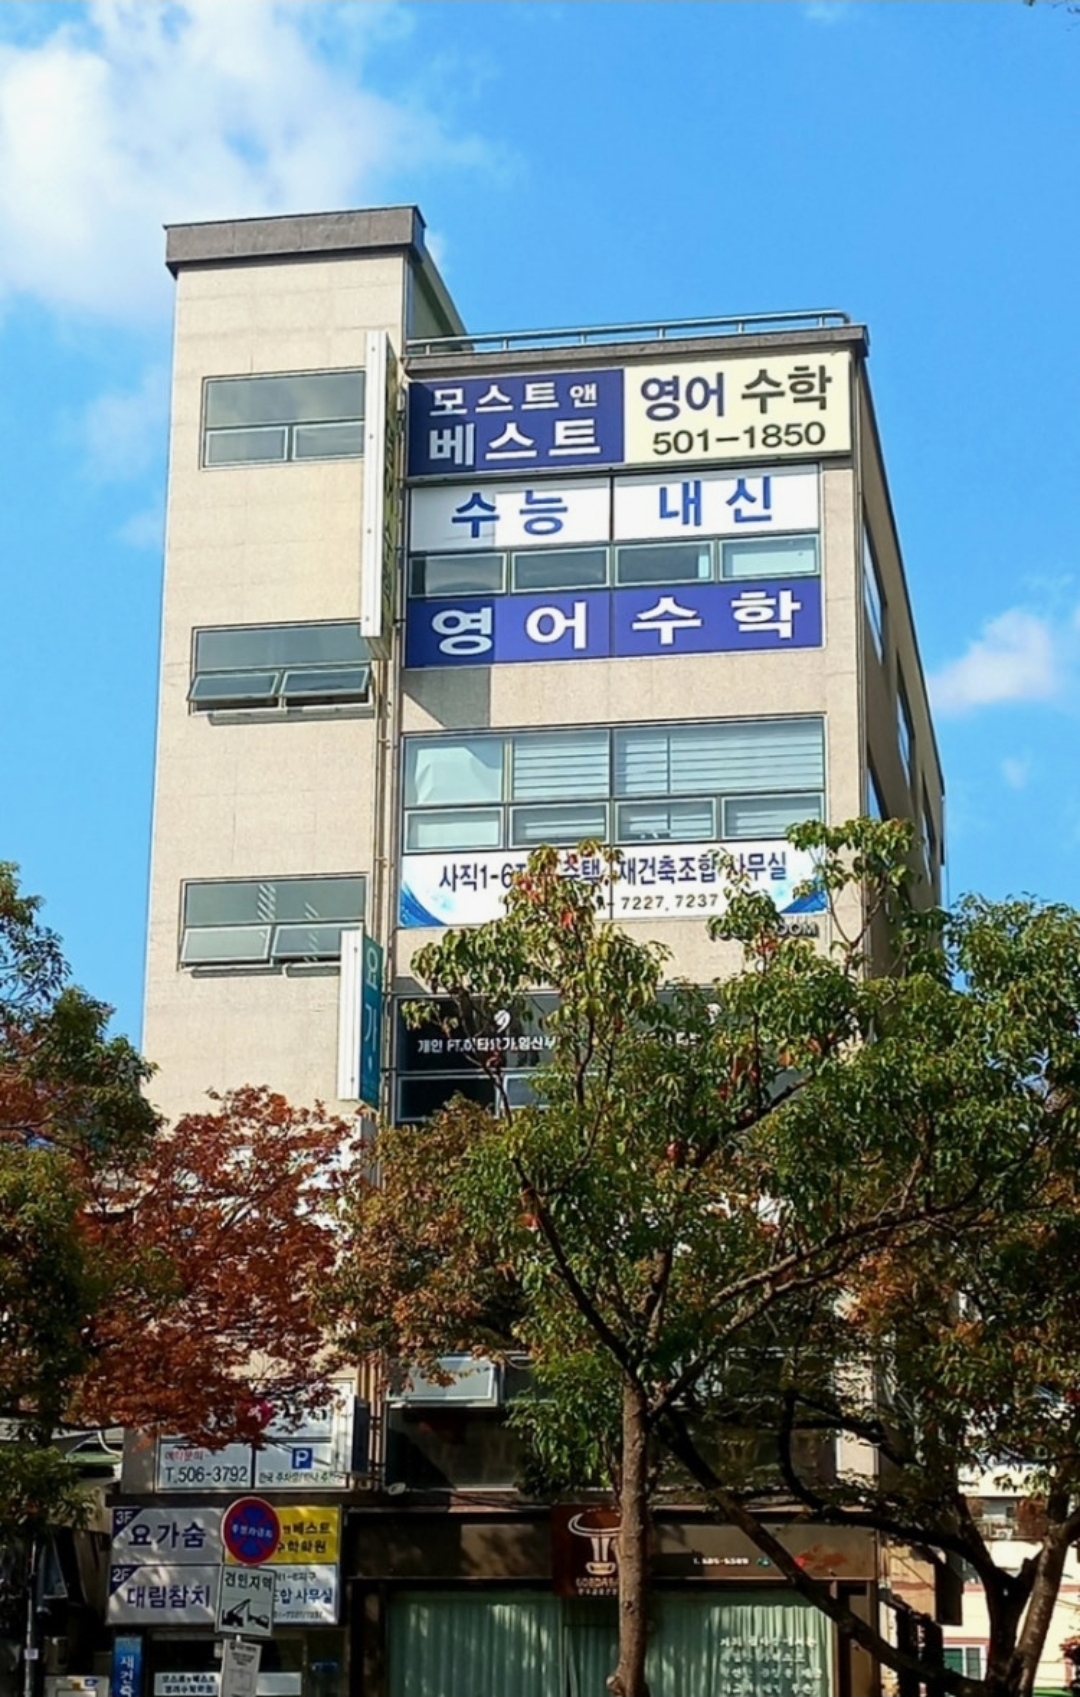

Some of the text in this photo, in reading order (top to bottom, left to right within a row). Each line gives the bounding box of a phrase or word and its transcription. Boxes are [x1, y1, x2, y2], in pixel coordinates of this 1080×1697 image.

[429, 382, 598, 418] 모스트 앤
[640, 364, 833, 421] 영어 수학
[429, 418, 601, 466] 베스트
[652, 421, 826, 456] 501-1850
[451, 475, 773, 538] 수능 내신
[675, 893, 718, 908] 7237
[165, 1465, 248, 1483] T.506-3792
[116, 1511, 134, 1525] 3F
[128, 1522, 206, 1548] 요가숨
[112, 1568, 131, 1582] 2F
[225, 1572, 273, 1591] 견인지역
[127, 1585, 210, 1608] 대림참치
[295, 1587, 333, 1604] 사무실
